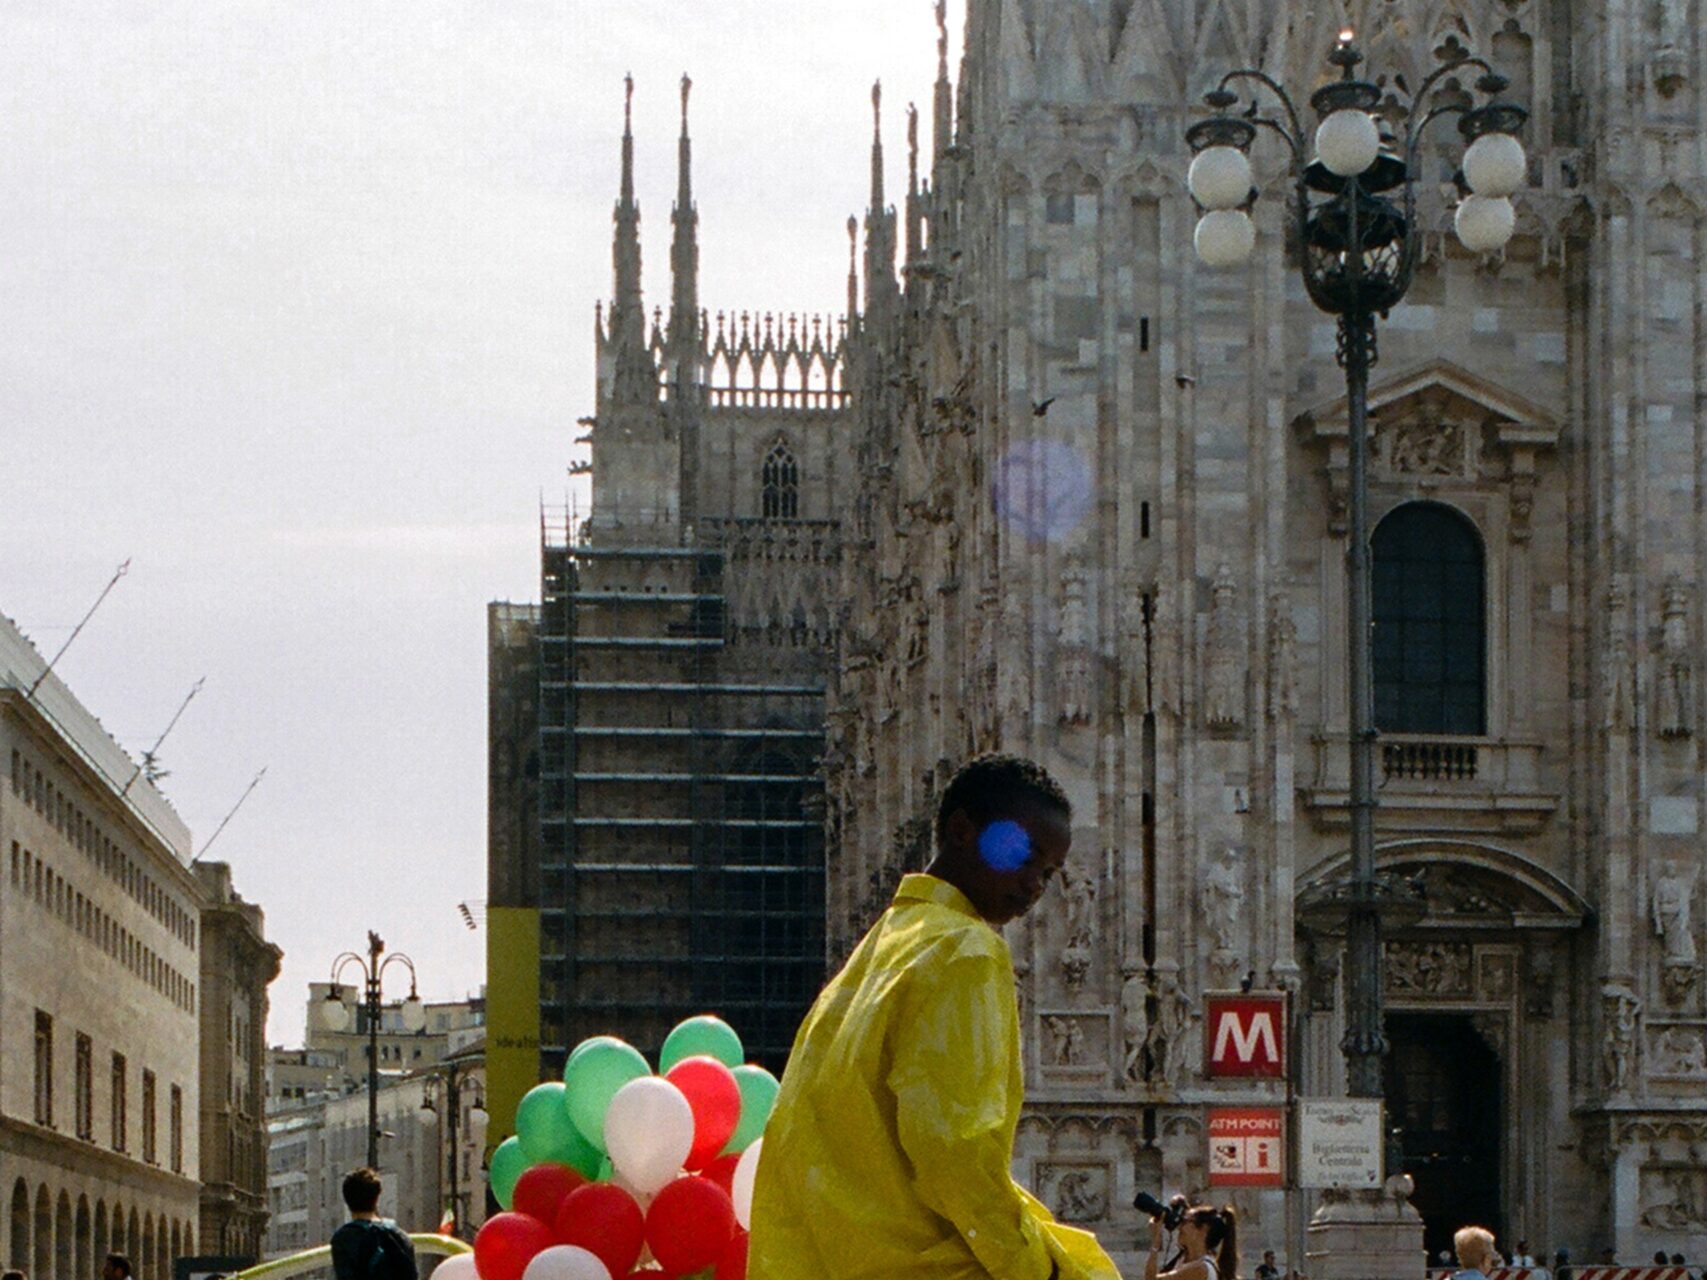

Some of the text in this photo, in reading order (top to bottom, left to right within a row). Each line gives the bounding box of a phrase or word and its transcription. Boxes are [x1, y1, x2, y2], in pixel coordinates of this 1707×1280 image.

[1212, 1012, 1279, 1062] M
[1209, 1118, 1280, 1129] ATM POINT
